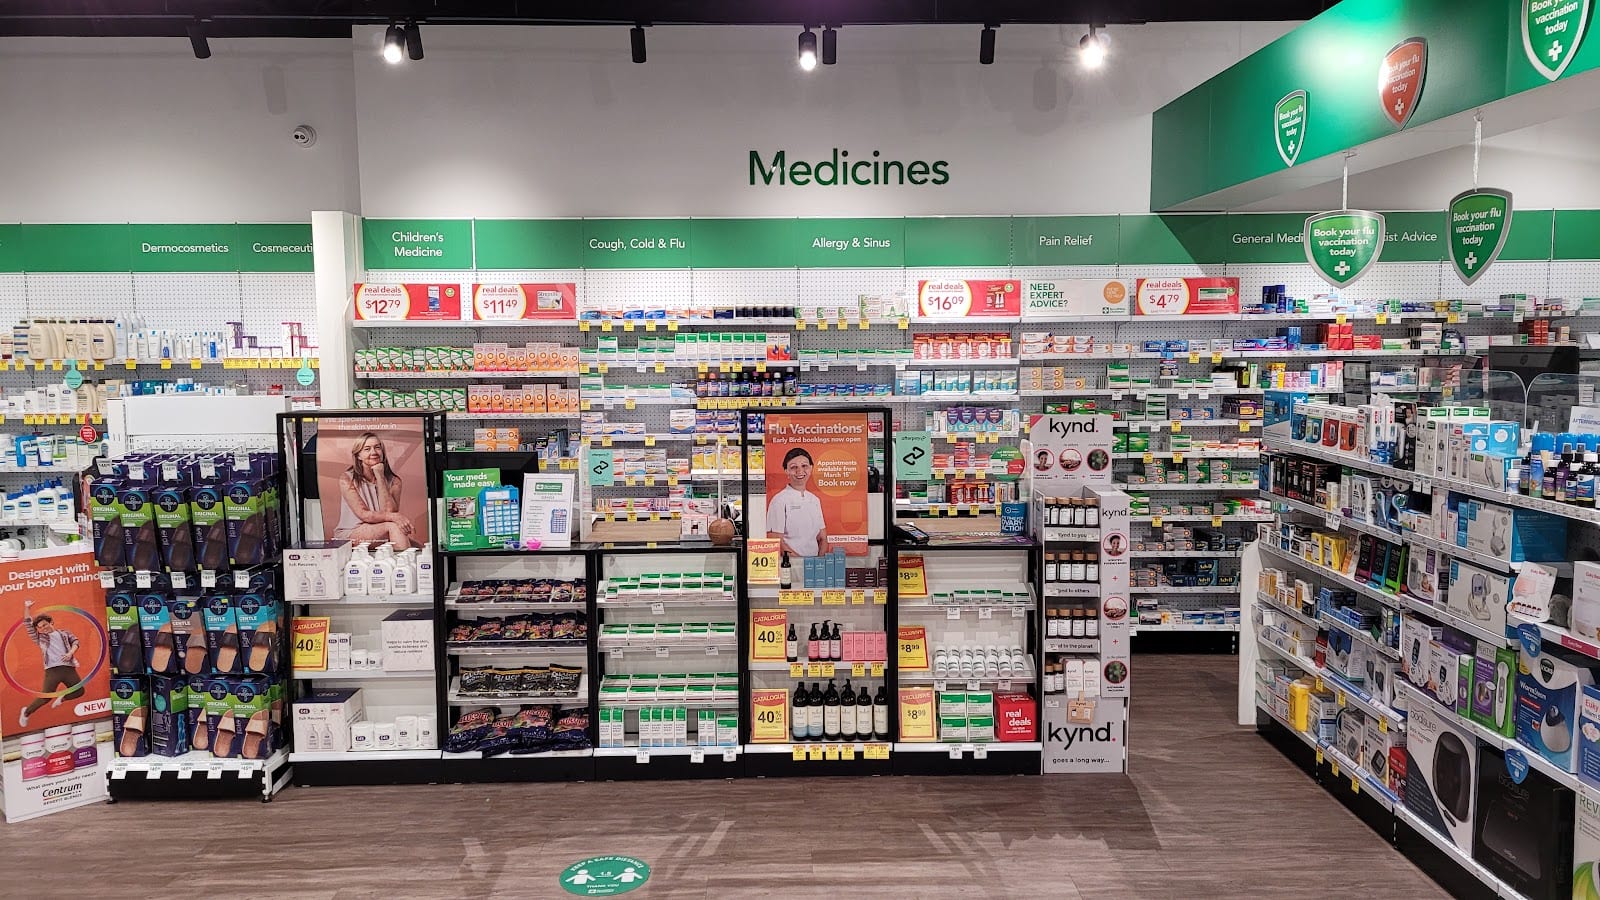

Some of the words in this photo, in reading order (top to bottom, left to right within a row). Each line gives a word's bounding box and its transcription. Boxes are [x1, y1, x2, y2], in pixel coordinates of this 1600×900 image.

[1535, 1, 1578, 25] vaccination
[1545, 19, 1568, 36] today
[1392, 81, 1408, 94] today
[749, 148, 950, 186] Medicines
[1453, 211, 1470, 222] Book
[1470, 210, 1490, 223] your
[1490, 207, 1502, 219] flu
[1455, 221, 1495, 233] vaccination
[391, 231, 444, 243] Children's
[1232, 233, 1274, 245] General
[1401, 231, 1438, 242] Advice
[1314, 227, 1336, 237] Book
[1338, 229, 1360, 240] your
[1362, 227, 1375, 236] flu
[589, 238, 627, 251] Cough,
[629, 238, 655, 249] Cold
[657, 238, 667, 249] &
[669, 238, 686, 249] Flu
[811, 237, 849, 251] Allergy
[851, 238, 861, 248] &
[863, 237, 891, 248] Sinus
[1039, 236, 1062, 246] Pain
[1063, 235, 1093, 246] Relief
[1318, 237, 1369, 247] vaccination
[1462, 234, 1483, 247] today
[141, 242, 229, 254] Dermocosmetics
[393, 246, 443, 257] Medicine
[1329, 246, 1357, 258] today
[364, 286, 380, 294] real
[380, 285, 402, 294] deals
[498, 285, 519, 293] deals
[928, 282, 943, 290] real
[943, 282, 964, 290] deals
[1029, 283, 1056, 291] NEED
[1146, 281, 1161, 289] real
[1161, 280, 1182, 289] deals
[1029, 291, 1064, 300] EXPERT
[1029, 300, 1069, 308] ADVICE?
[768, 424, 787, 435] Flu
[772, 437, 787, 445] Early
[446, 474, 465, 482] Your
[465, 472, 488, 480] meds
[453, 480, 476, 488] made
[477, 480, 496, 488] easy
[818, 479, 839, 487] Book
[1102, 508, 1127, 519] kynd
[751, 556, 769, 568] 40
[8, 566, 63, 581] Designed
[65, 563, 90, 574] with
[0, 581, 25, 595] your
[26, 577, 58, 590] body
[59, 575, 71, 585] in
[72, 571, 101, 583] mind
[753, 613, 787, 623] CATALOGUE
[757, 630, 775, 643] 40
[296, 639, 314, 652] 40
[753, 693, 786, 703] CATALOGUE
[901, 692, 931, 701] EXCLUSIVE
[83, 701, 107, 712] NEW
[1585, 698, 1600, 712] Euky
[757, 710, 775, 723] 40
[1005, 709, 1022, 718] real
[1008, 717, 1032, 727] deals
[26, 782, 41, 792] What
[42, 781, 82, 799] Centrum
